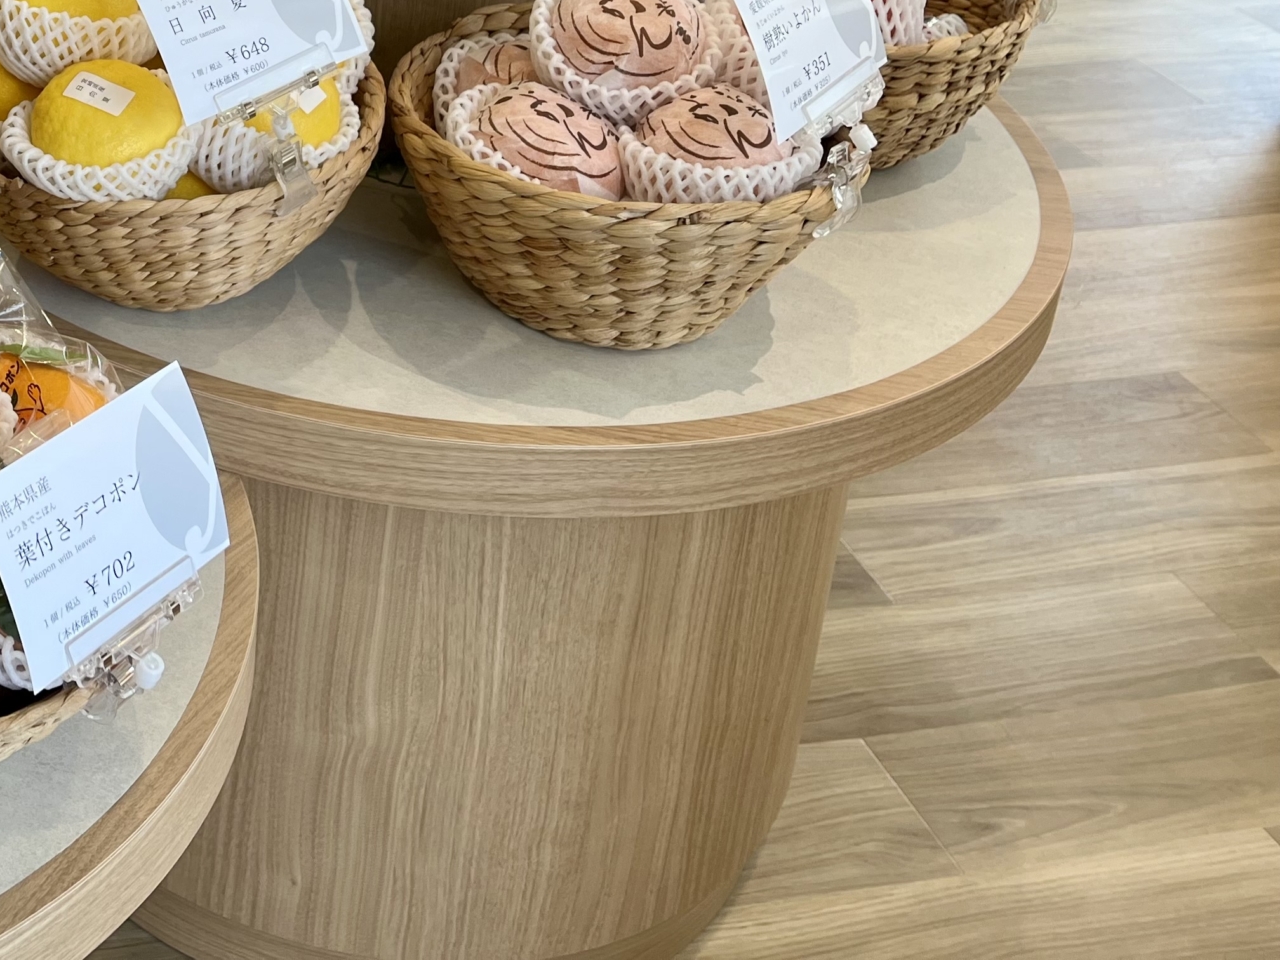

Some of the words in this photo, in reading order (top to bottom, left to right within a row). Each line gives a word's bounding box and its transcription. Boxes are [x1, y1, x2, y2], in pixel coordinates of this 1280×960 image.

[225, 36, 270, 64] ¥648
[762, 0, 822, 52] 樹熟いよかん
[6, 501, 57, 540] はつきでこぽん
[14, 471, 142, 571] 葉付きデコポン
[24, 562, 57, 588] Dekopon
[57, 547, 73, 565] with
[72, 533, 97, 556] leaves
[84, 550, 136, 597] ¥702
